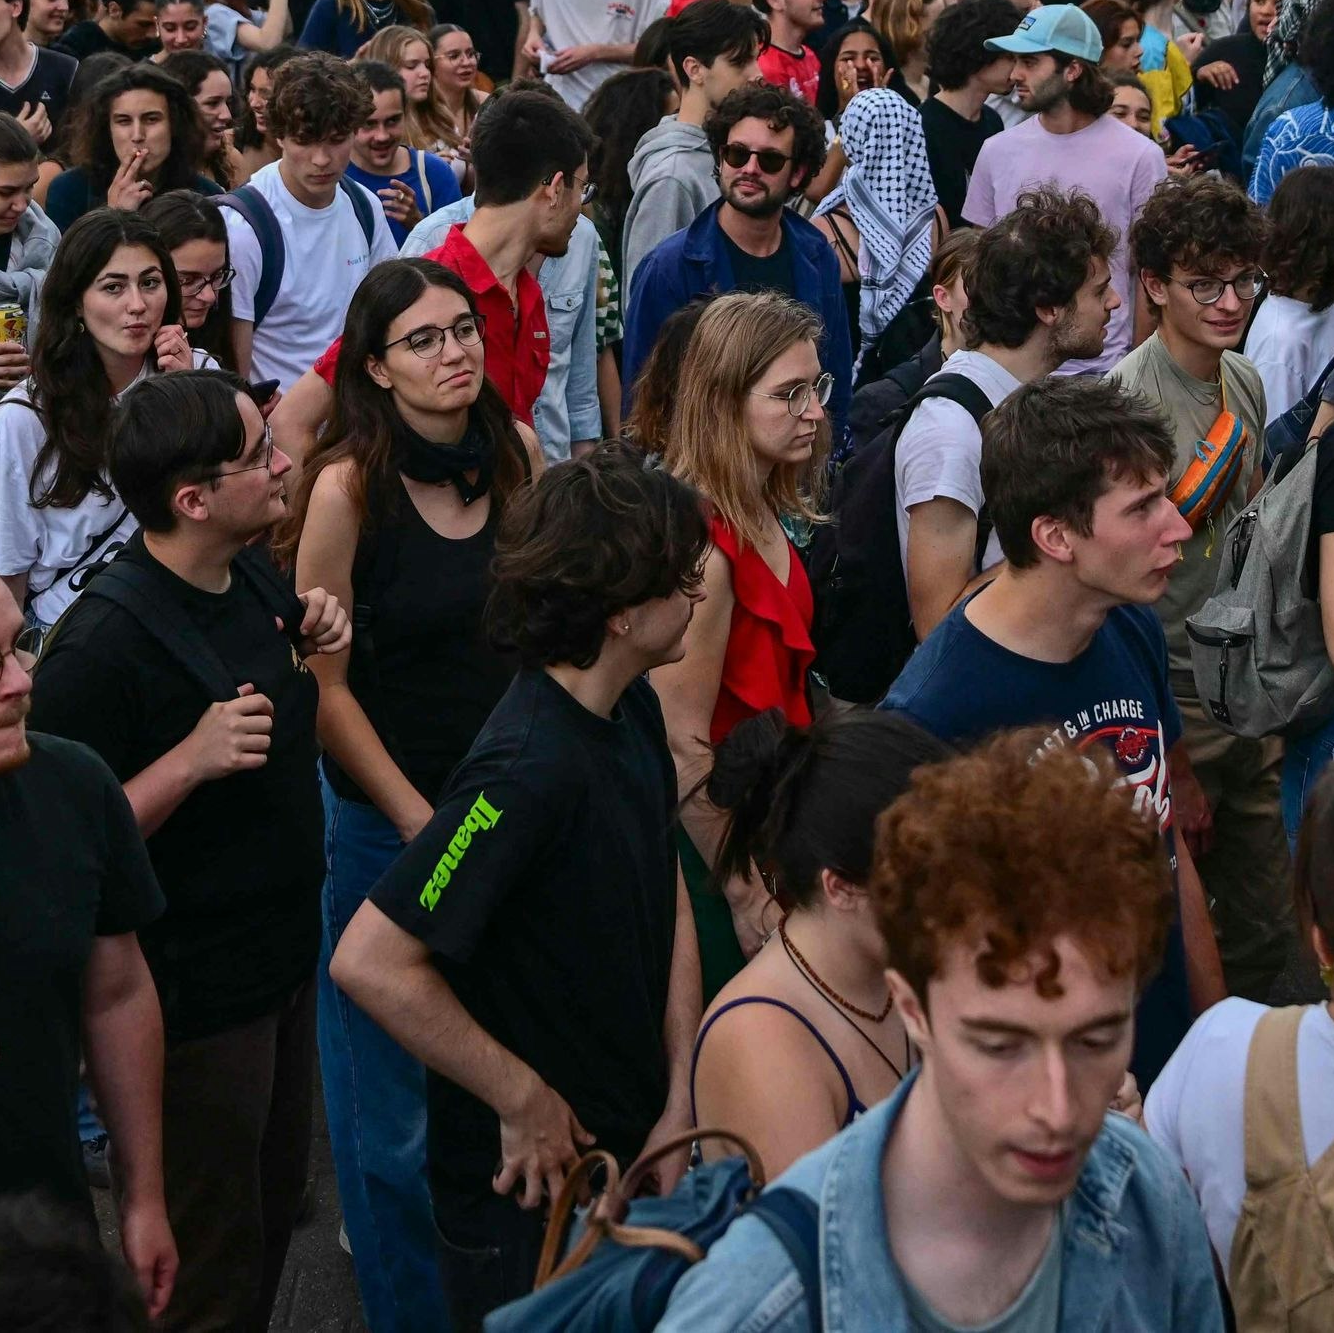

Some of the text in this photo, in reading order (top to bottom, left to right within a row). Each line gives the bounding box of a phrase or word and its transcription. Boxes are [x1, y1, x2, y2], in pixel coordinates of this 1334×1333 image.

[1063, 719, 1079, 739] &
[1076, 709, 1091, 730] IN
[1093, 698, 1145, 724] CHARGE
[420, 790, 504, 912] Ibanez
